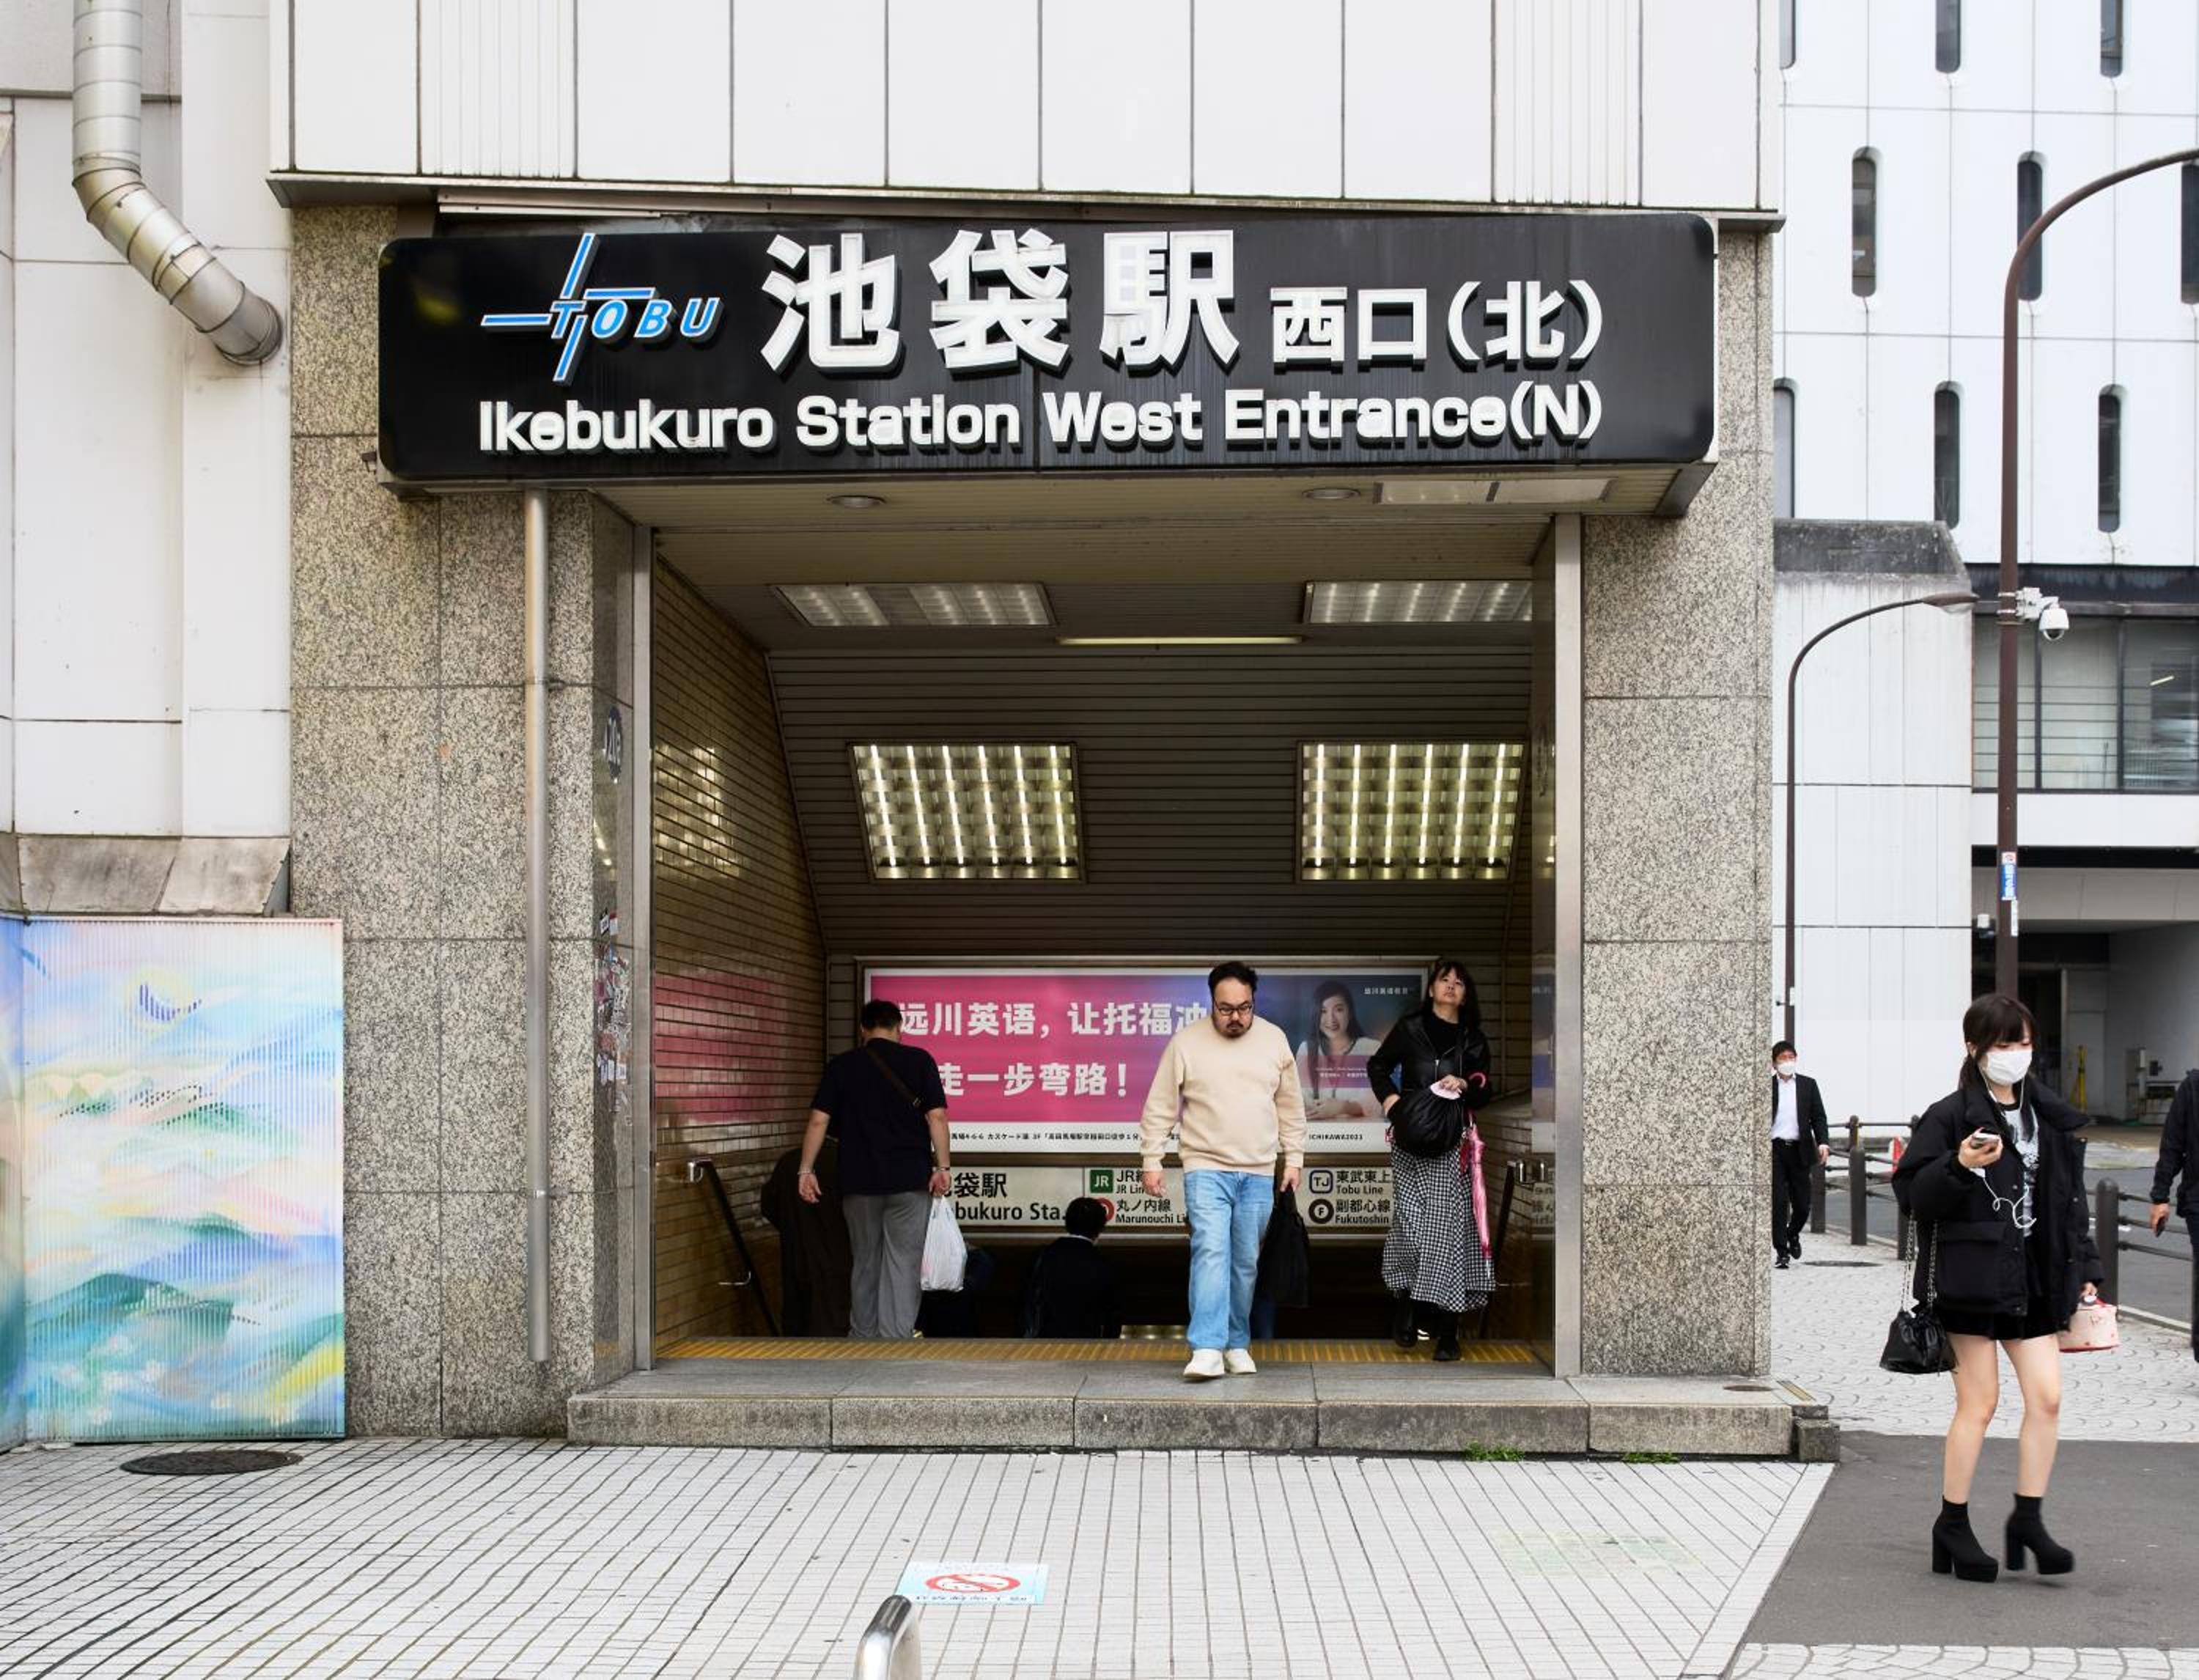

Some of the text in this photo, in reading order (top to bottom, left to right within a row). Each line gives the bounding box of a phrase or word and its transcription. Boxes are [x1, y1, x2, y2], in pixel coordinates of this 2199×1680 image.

[761, 228, 1240, 372] 池袋駅
[479, 380, 1603, 453] Ikebukuro Station West Entrance(N)
[1094, 1175, 1109, 1187] JR
[1313, 1176, 1330, 1187] TJ
[1336, 1171, 1391, 1184] 東武東上
[944, 1172, 1007, 1198] 袋駅
[1116, 1185, 1145, 1194] JR Lin
[1336, 1185, 1383, 1195] Tobu Line
[954, 1201, 1067, 1220] bukuro Sta.
[1116, 1198, 1171, 1212] 丸ノ内線
[1335, 1198, 1391, 1213] 副都心線
[1319, 1207, 1325, 1216] F
[1116, 1214, 1186, 1223] Marunouchi Li
[1335, 1214, 1390, 1224] Fukutoshin
